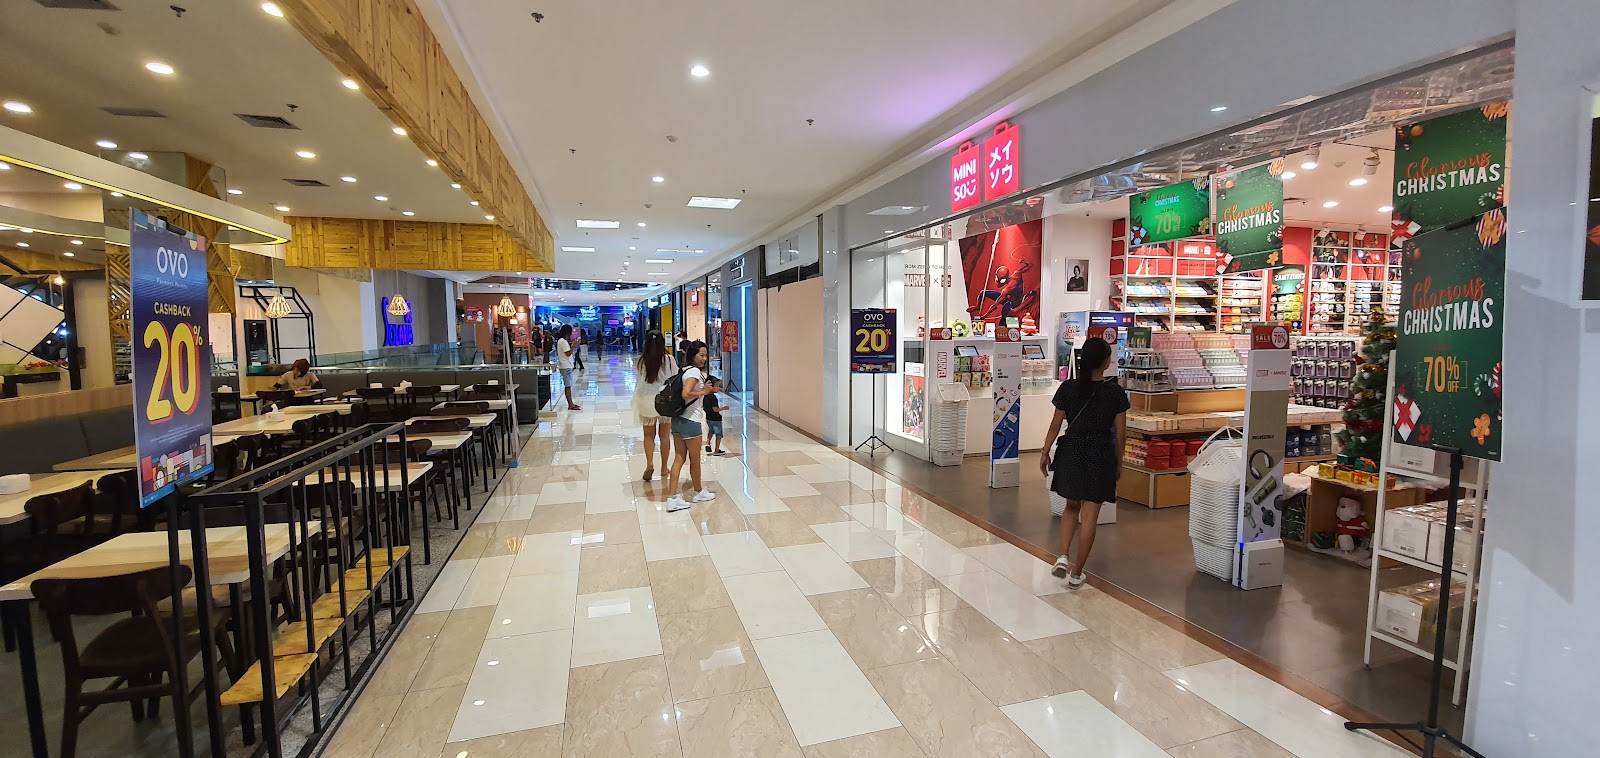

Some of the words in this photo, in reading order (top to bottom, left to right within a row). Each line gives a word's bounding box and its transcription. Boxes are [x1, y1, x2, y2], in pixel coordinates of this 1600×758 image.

[954, 158, 976, 183] MINI
[1406, 152, 1492, 180] Glorious
[1397, 163, 1501, 197] CHRISTMAS
[1155, 195, 1180, 207] CHRISTMAS
[1223, 201, 1275, 222] Glorious
[1155, 212, 1181, 235] 70%
[1218, 209, 1280, 235] CHRISTMAS
[156, 246, 189, 279] OVO
[1411, 275, 1486, 311] Glorious
[154, 301, 191, 317] CASHBACK
[863, 313, 884, 321] OVO
[1404, 298, 1494, 336] CHRISTMAS
[855, 328, 892, 352] 20%
[1274, 333, 1286, 344] 70%
[144, 320, 203, 424] 20%
[937, 351, 947, 378] MARVEL
[1423, 355, 1460, 393] 70%
[1447, 380, 1460, 393] OFF
